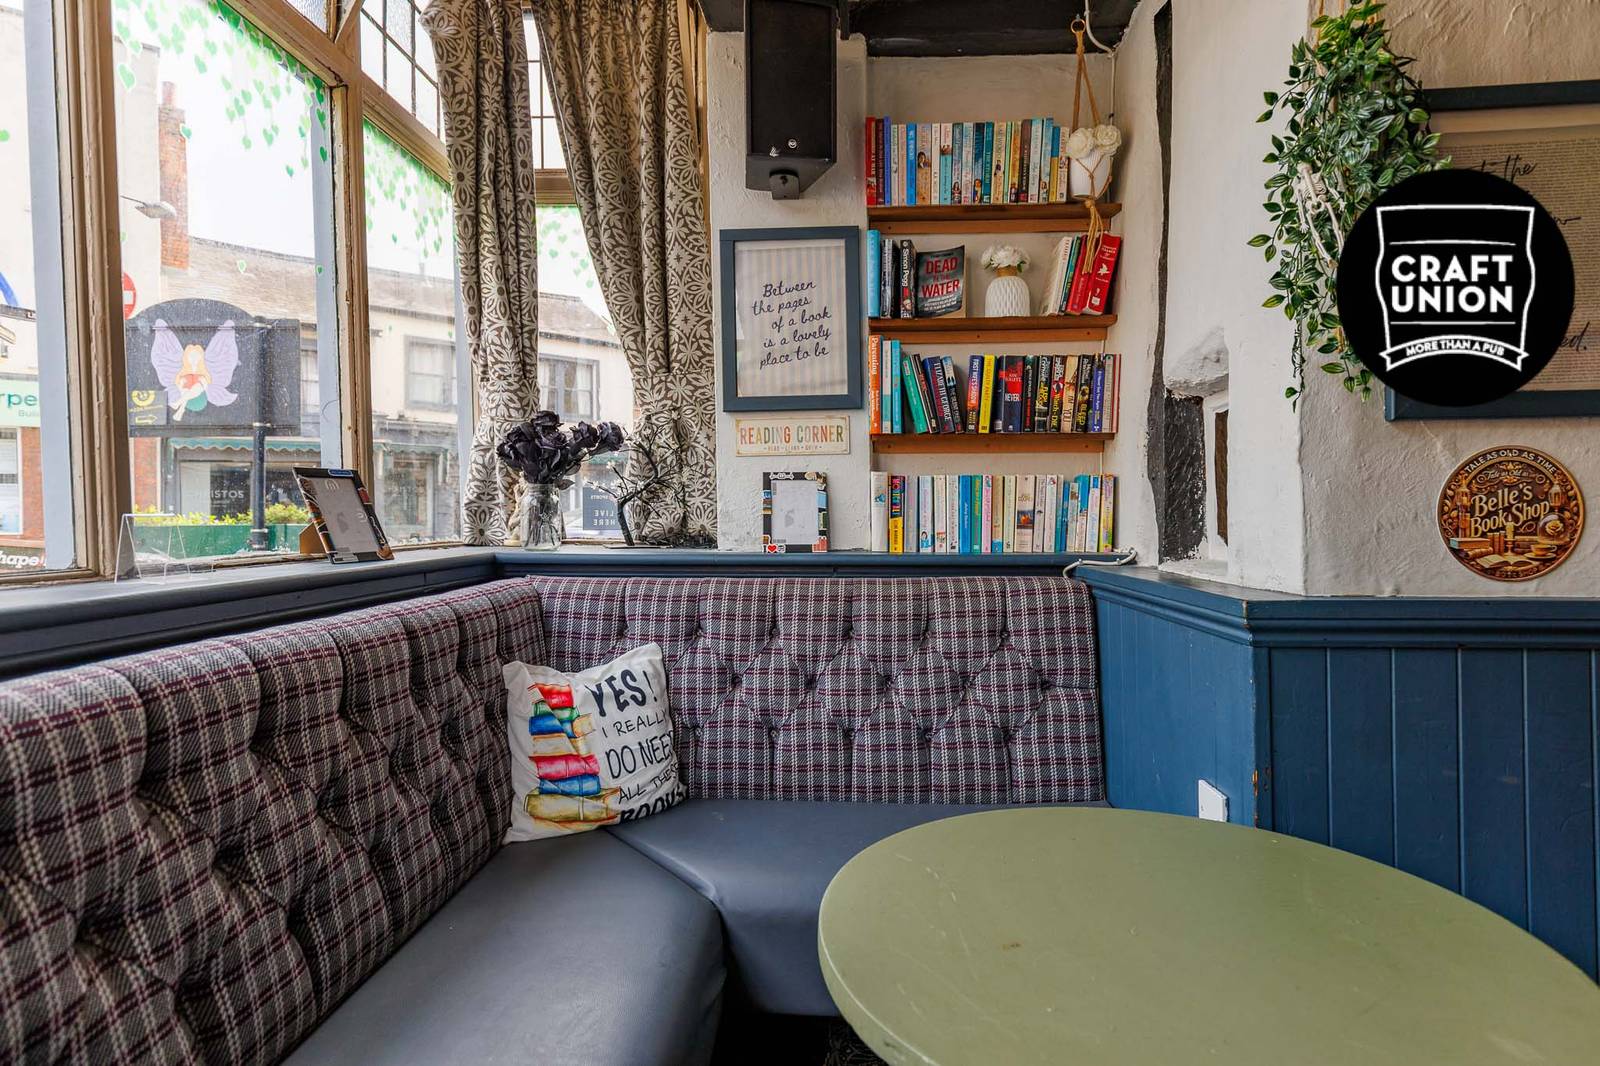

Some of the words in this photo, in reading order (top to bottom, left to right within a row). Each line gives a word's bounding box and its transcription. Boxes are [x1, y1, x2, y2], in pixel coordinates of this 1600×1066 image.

[902, 248, 910, 270] Simon
[926, 257, 958, 274] DEAD
[762, 280, 817, 298] Between
[902, 270, 910, 287] Pegg
[922, 279, 960, 298] WATER
[752, 301, 774, 316] the
[777, 296, 811, 314] pages
[771, 316, 785, 333] of
[788, 316, 797, 326] a
[801, 306, 832, 324] book
[763, 337, 776, 348] is
[780, 336, 790, 346] a
[793, 324, 832, 343] lovely
[759, 350, 793, 370] place
[795, 346, 811, 361] to
[814, 342, 830, 356] be
[934, 362, 948, 396] ELIZABETH
[940, 396, 952, 422] GEORGE
[740, 426, 792, 445] READING
[796, 424, 844, 442] CORNER
[1464, 456, 1485, 474] TALE
[1486, 451, 1498, 461] AS
[1500, 449, 1519, 457] OLD
[1522, 451, 1535, 461] AS
[1537, 456, 1557, 474] TIME
[1471, 482, 1534, 517] Belle's
[1470, 510, 1508, 537] Book
[1511, 501, 1550, 526] Shop
[584, 668, 658, 718] YES!
[602, 726, 608, 738] I
[606, 744, 638, 780] DO
[618, 782, 648, 804] ALL
